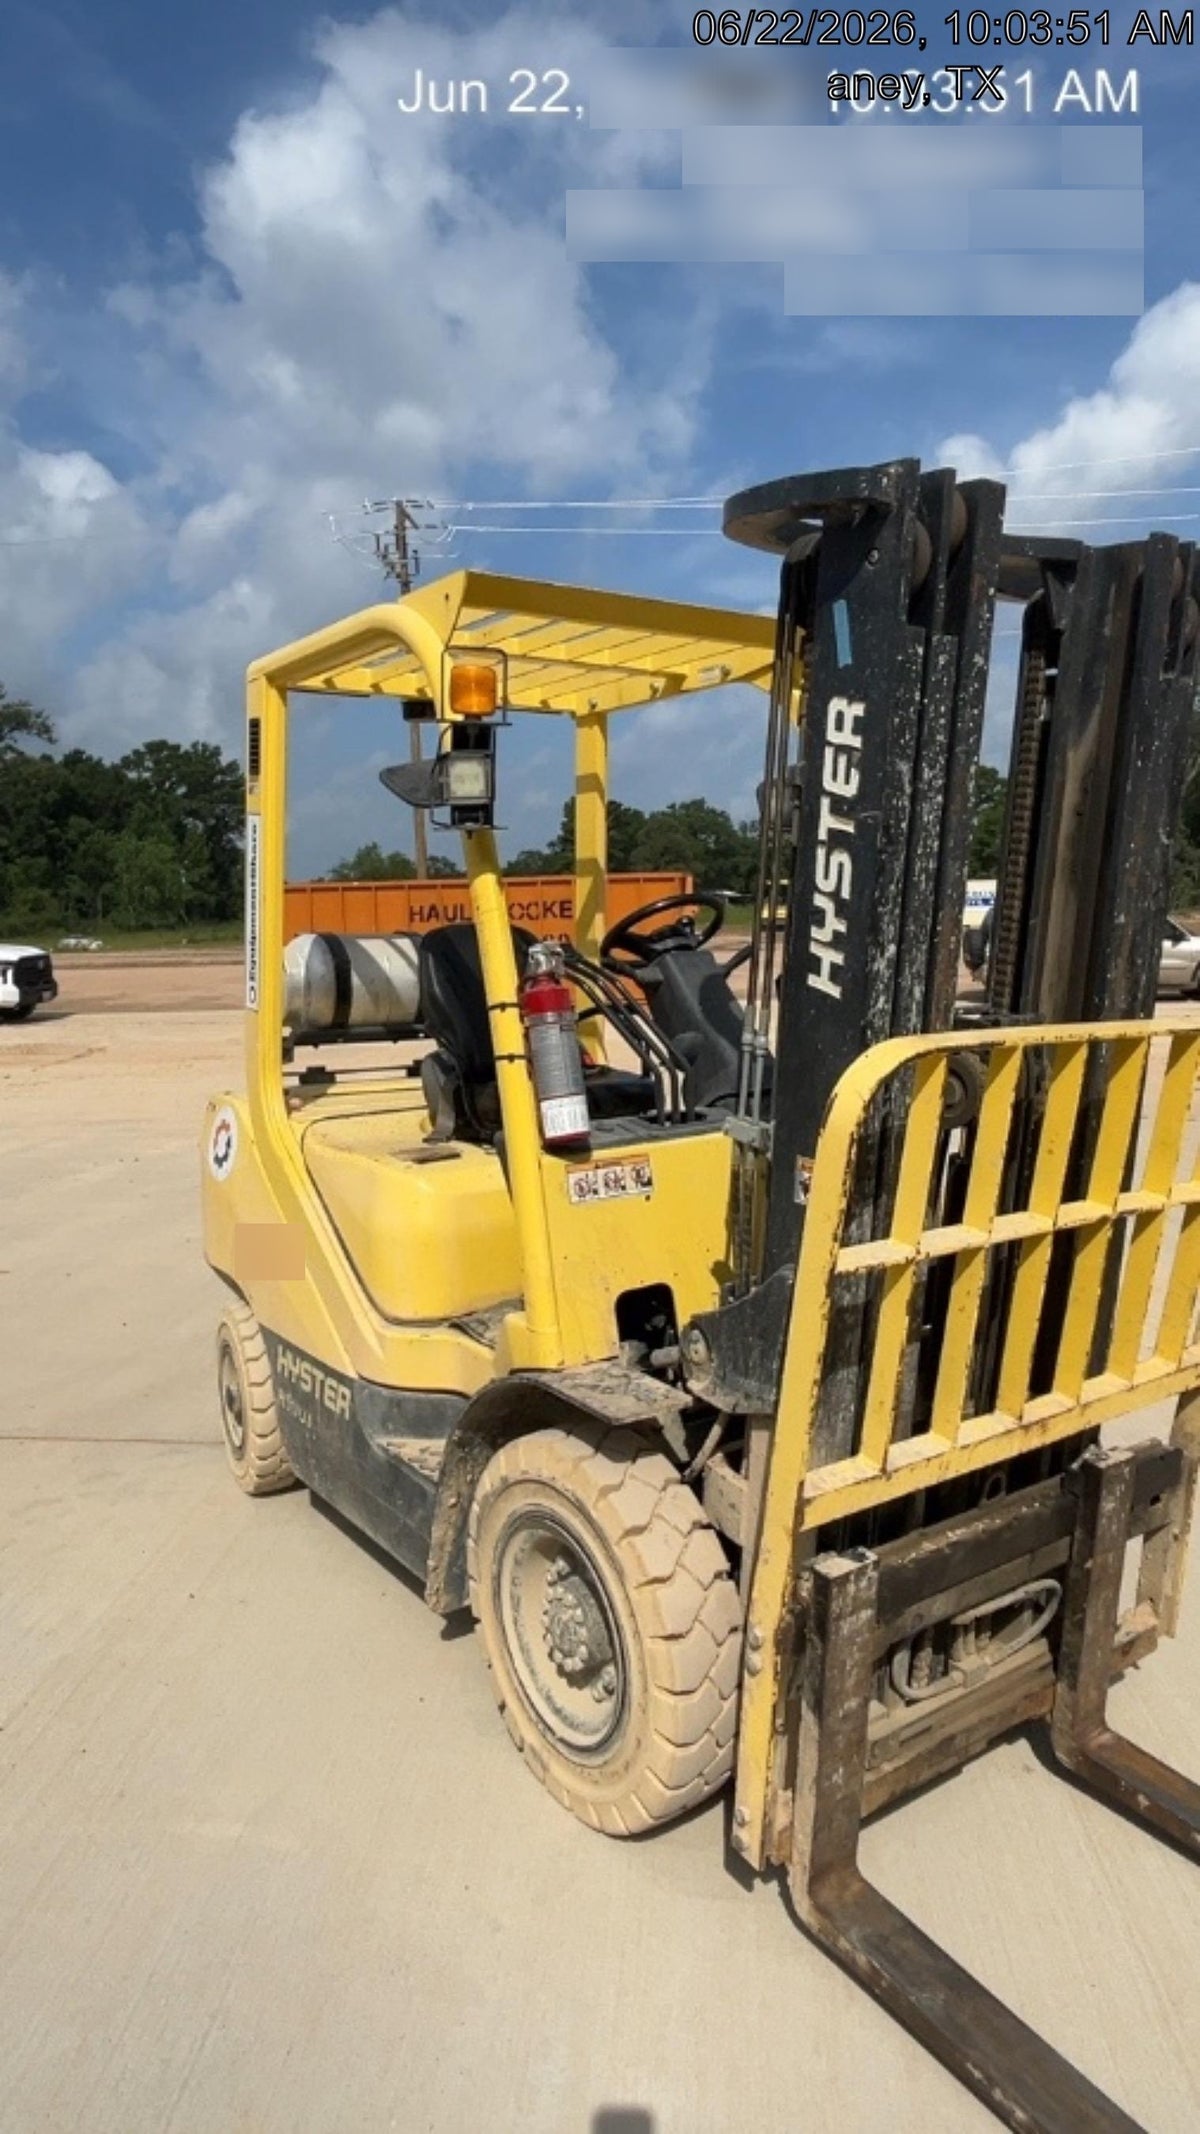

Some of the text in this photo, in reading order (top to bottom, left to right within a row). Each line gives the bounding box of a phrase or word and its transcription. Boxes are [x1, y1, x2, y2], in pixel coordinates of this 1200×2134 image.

[807, 697, 865, 999] HYSTER
[409, 900, 574, 923] HAUL OCKE
[277, 1344, 351, 1420] HYSTER
